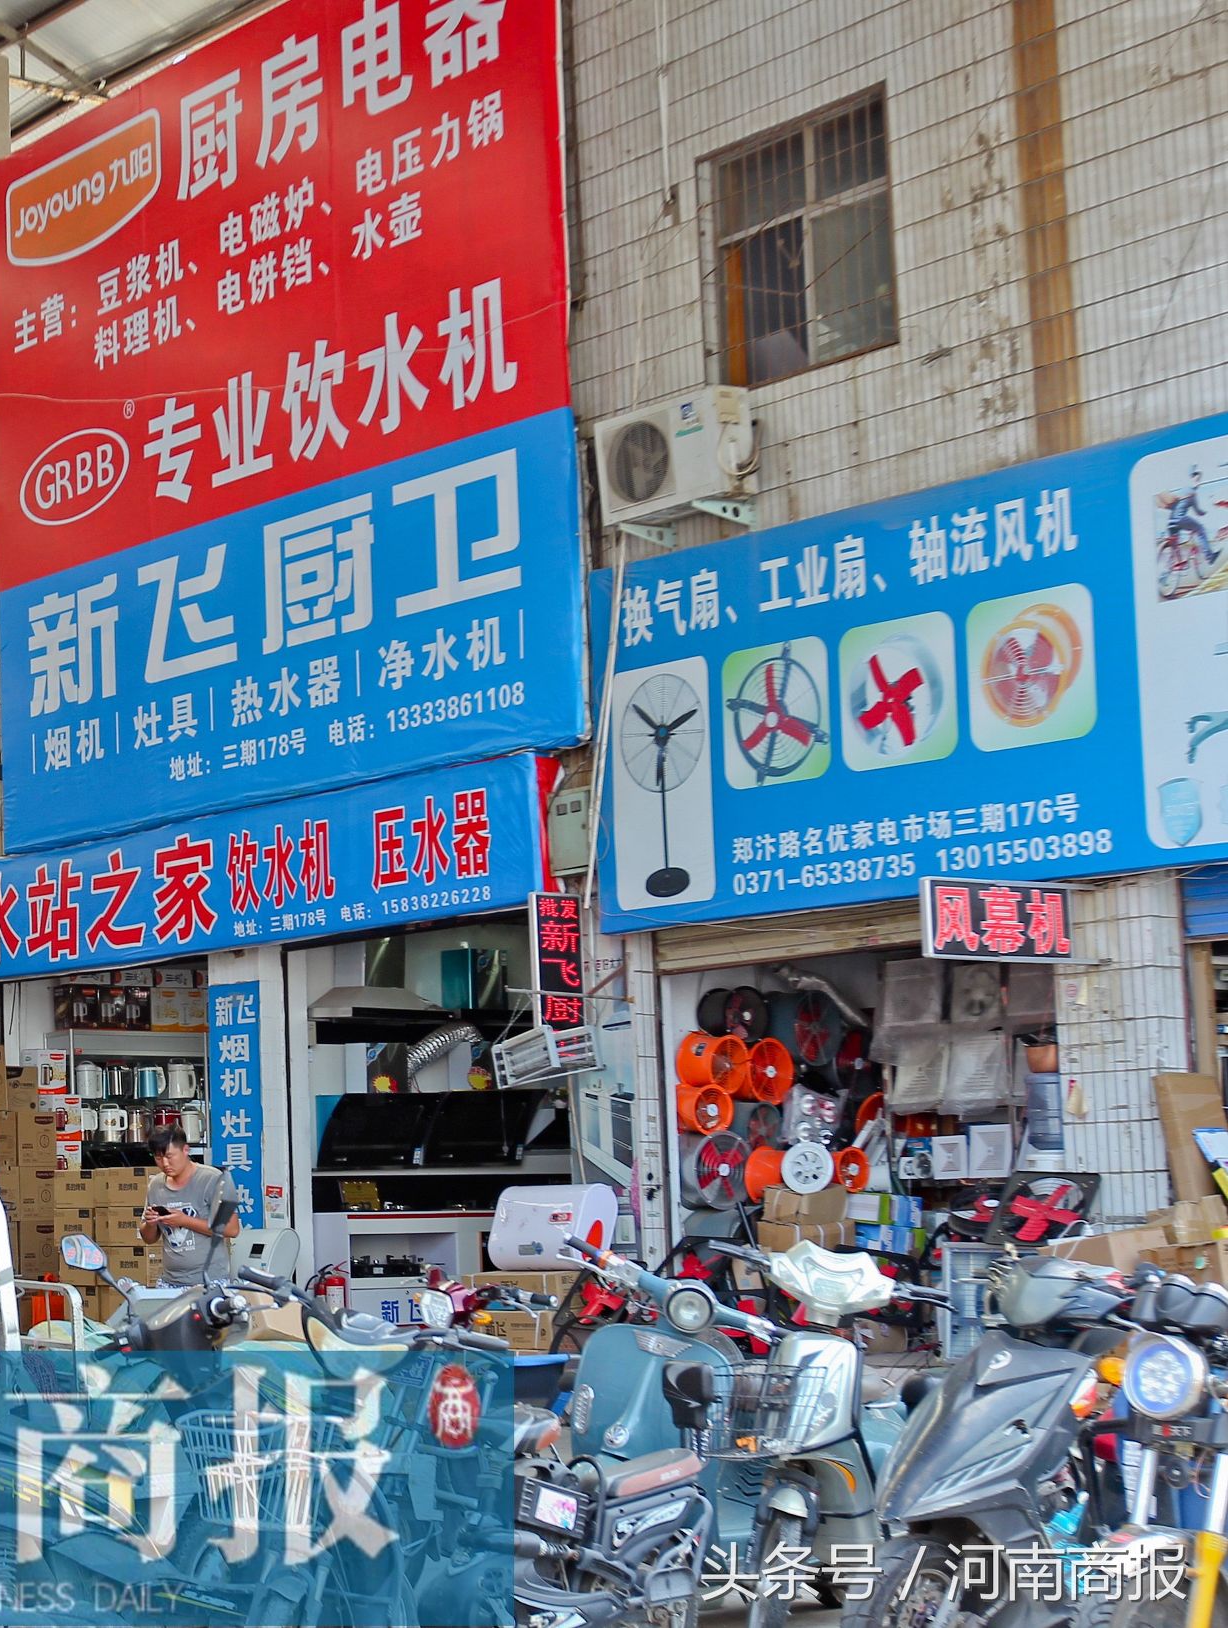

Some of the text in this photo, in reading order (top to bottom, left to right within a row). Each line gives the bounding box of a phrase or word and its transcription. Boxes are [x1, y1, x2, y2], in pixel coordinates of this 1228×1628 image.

[176, 0, 509, 200] 厨房电器
[14, 141, 153, 239] Joyoung 九阳
[14, 292, 77, 353] 主营：
[143, 277, 518, 504] 专业饮水机
[35, 442, 116, 510] GRBB
[28, 448, 522, 718] 新飞厨卫
[43, 615, 506, 772] 烟机 灶具 热水器 净水机
[226, 817, 335, 915] 饮水机
[372, 786, 491, 894] 压水器
[732, 793, 1081, 864] 郑汴路名优家电市场三期176号
[733, 829, 1113, 897] 0371-65338735 13015503898
[540, 897, 579, 919] 批发
[933, 886, 1071, 954] 风幕机
[215, 995, 260, 1027] 新飞
[218, 1034, 252, 1098] 烟机
[220, 1109, 253, 1172] 灶具
